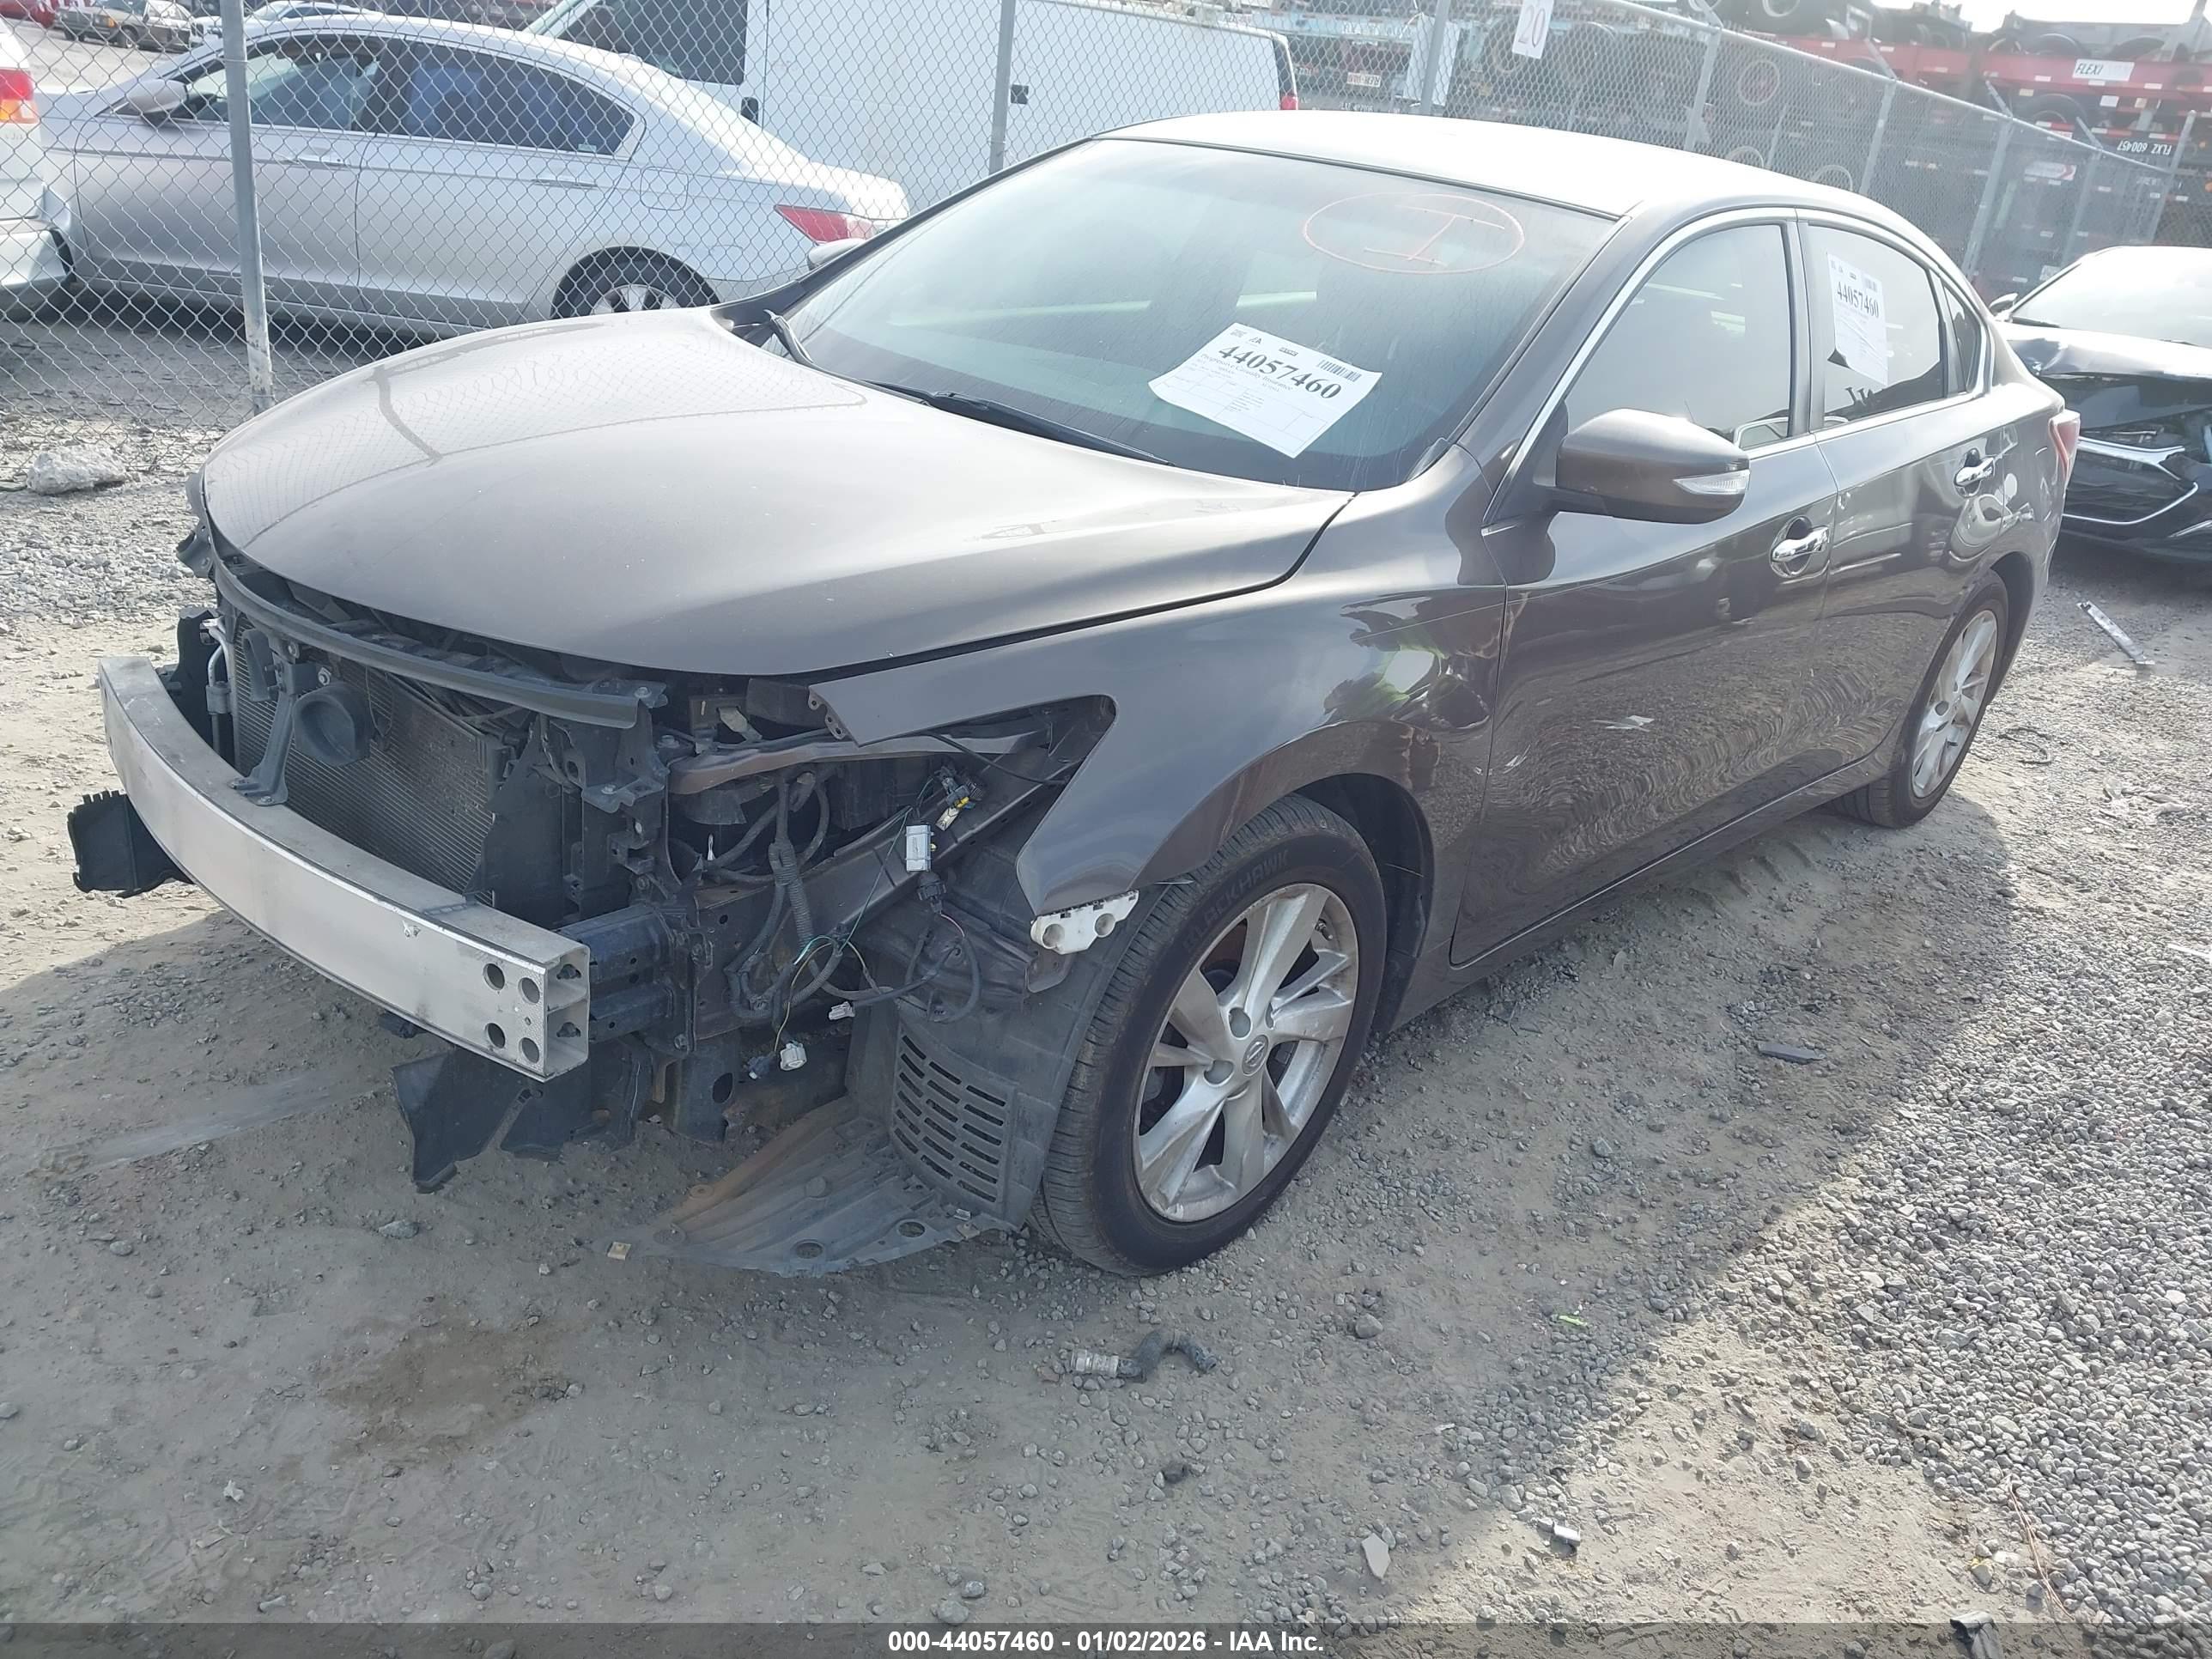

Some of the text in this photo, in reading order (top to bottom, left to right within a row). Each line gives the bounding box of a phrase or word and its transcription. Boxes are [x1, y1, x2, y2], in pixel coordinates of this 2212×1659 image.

[2075, 63, 2104, 76] FLEXI
[2117, 140, 2172, 155] FLXZ 600457
[1837, 280, 1880, 319] 44057460
[1218, 345, 1342, 399] 44057460
